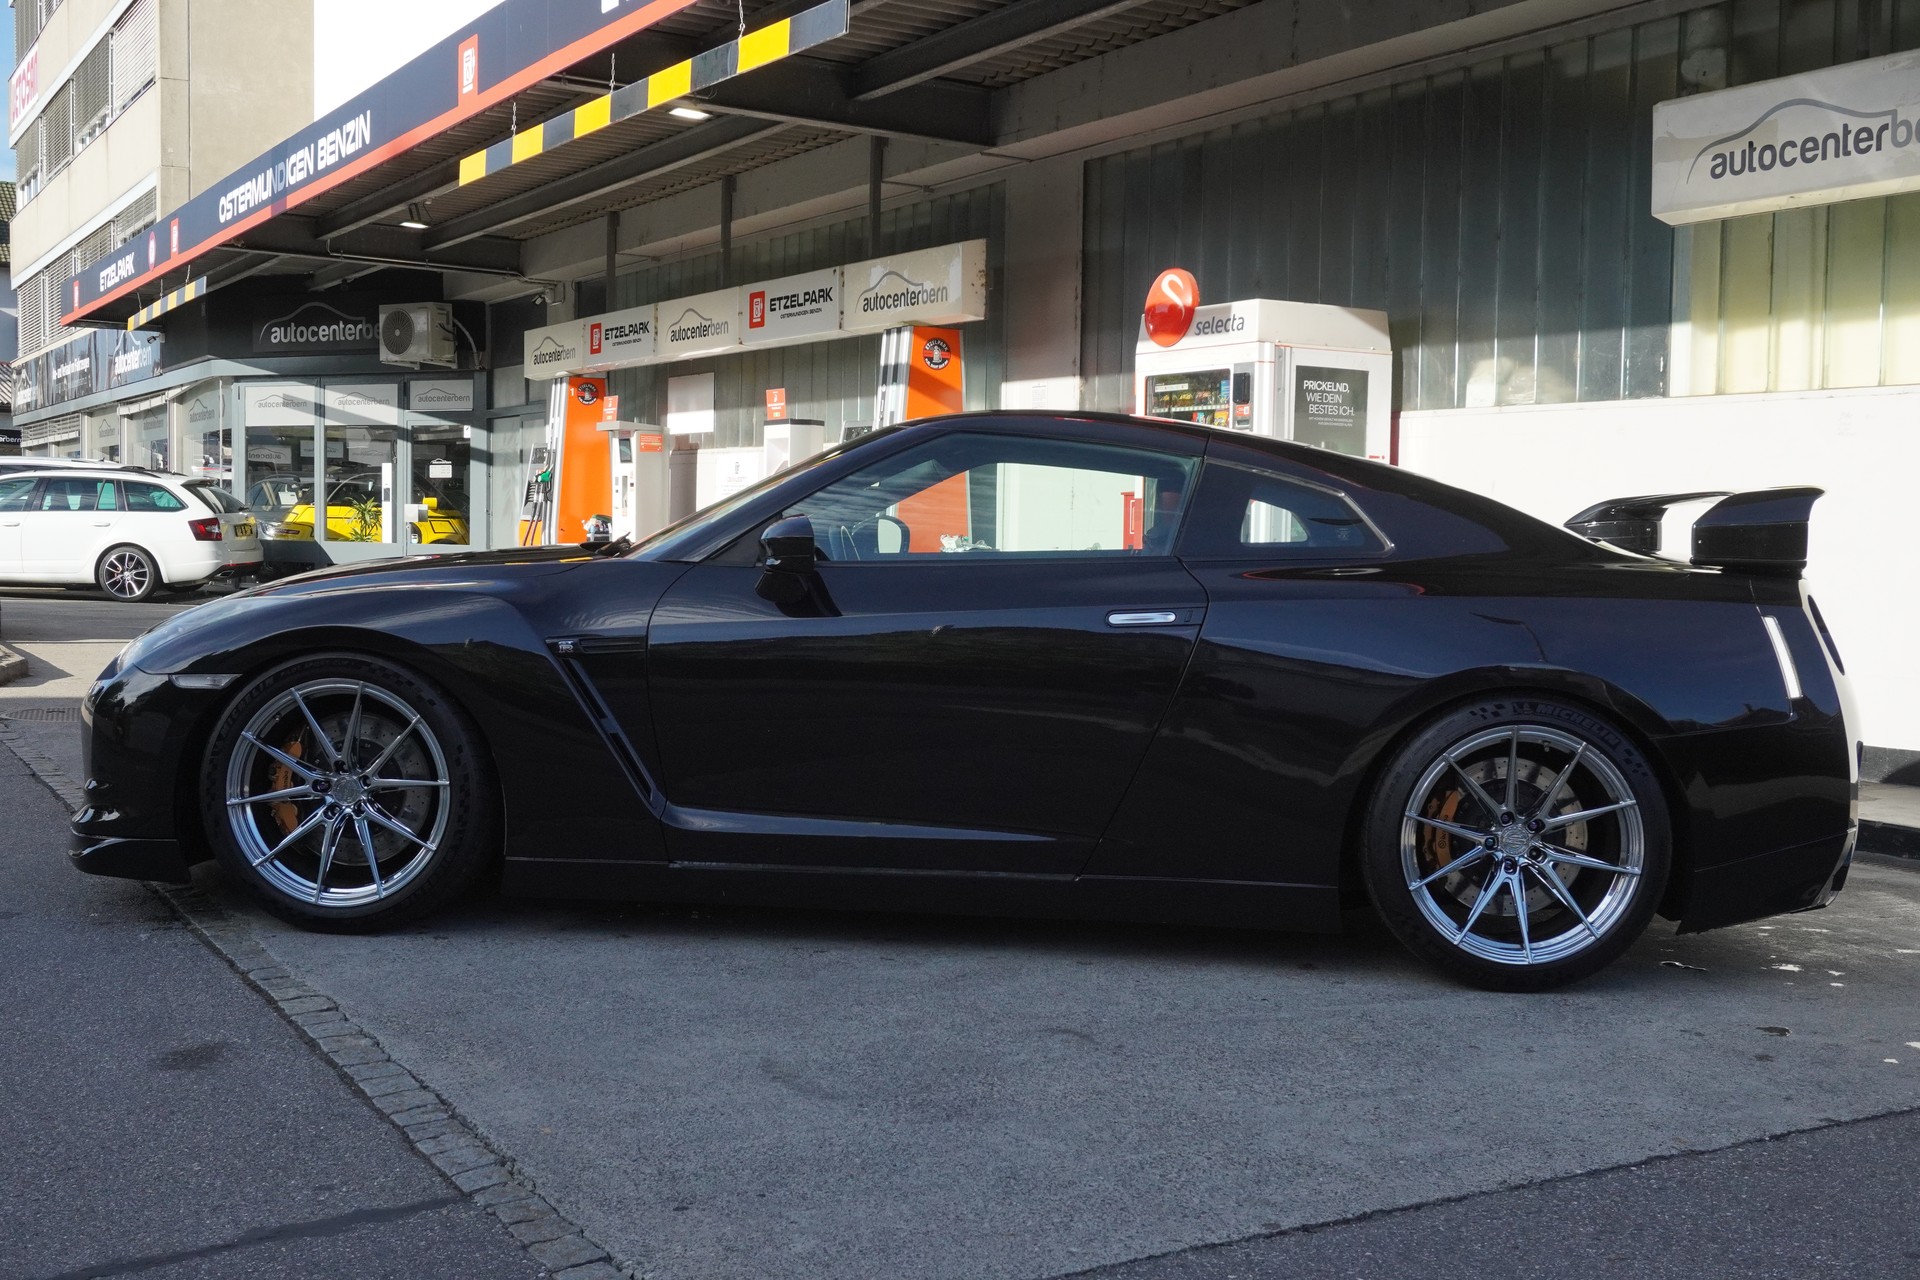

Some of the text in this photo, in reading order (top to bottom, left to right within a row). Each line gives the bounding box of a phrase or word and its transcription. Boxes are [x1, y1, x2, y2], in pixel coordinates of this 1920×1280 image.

[218, 109, 371, 224] OSTERMUNDIGEN BENZIN
[100, 251, 135, 292] ETZELPARK
[769, 286, 833, 313] ETZELPARK
[863, 284, 949, 313] autocenterbern
[604, 320, 650, 341] ETZELPARK
[671, 319, 728, 343] autocenterbern
[1194, 313, 1245, 336] selecta
[533, 345, 576, 366] autocenterbern
[569, 387, 575, 396] 1
[1303, 380, 1350, 393] PRICKELND,
[257, 398, 307, 409] autocenterbern
[337, 396, 390, 407] autocenterbern
[418, 394, 470, 403] autocenterbern
[1306, 392, 1342, 403] WIE DEIN
[1309, 404, 1355, 416] BESTES ICH.
[1537, 703, 1622, 750] MICHELIN
